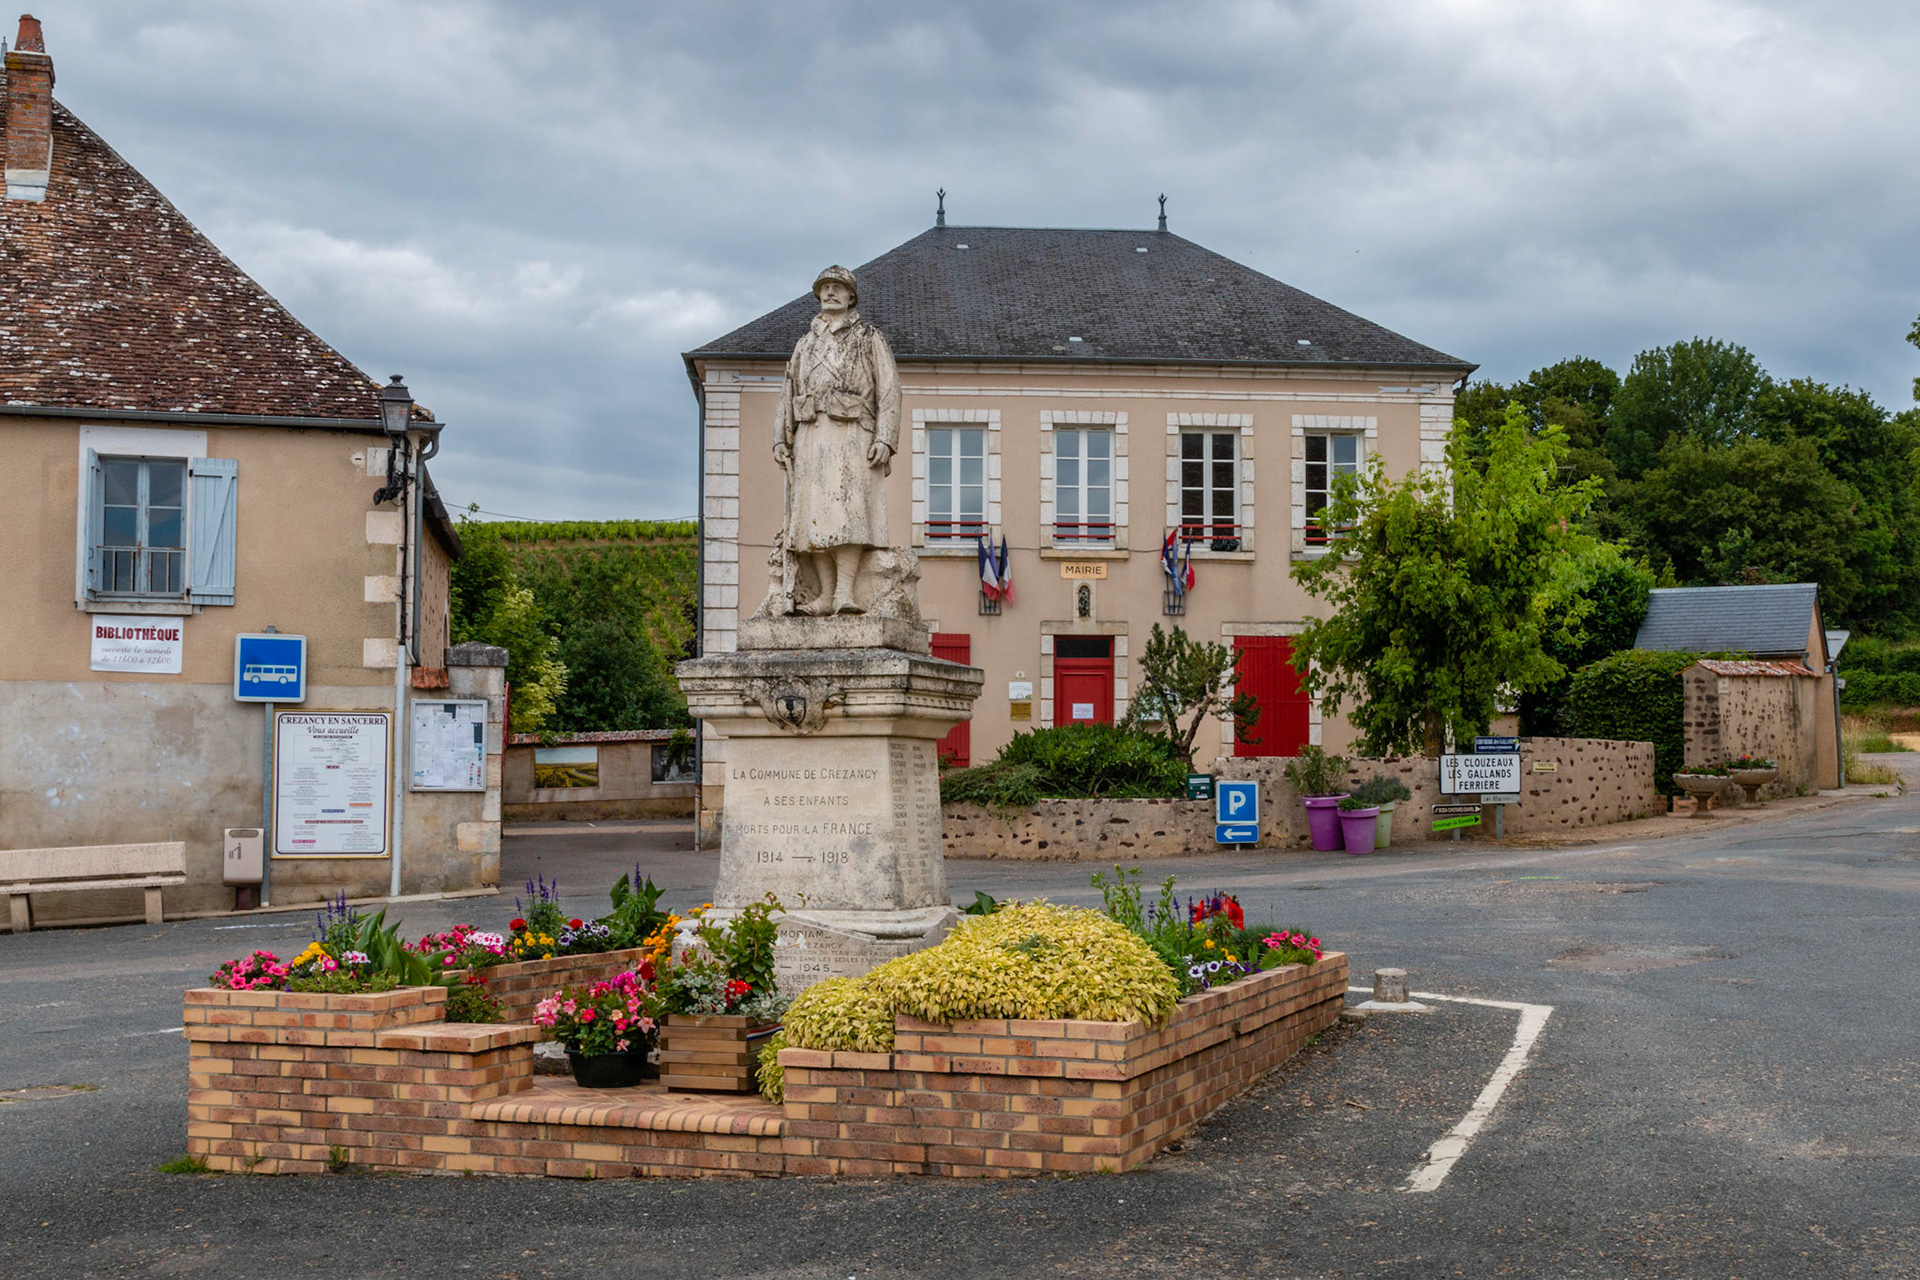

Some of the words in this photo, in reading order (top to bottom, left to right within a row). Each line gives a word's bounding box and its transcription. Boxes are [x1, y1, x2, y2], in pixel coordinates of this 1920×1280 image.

[1065, 565, 1103, 575] MAIRIE
[95, 626, 179, 641] BIBLIOTHÈQUE
[144, 646, 172, 655] samedi
[280, 716, 327, 725] CREZANCY
[328, 717, 340, 725] EN
[341, 717, 386, 726] SANCERRE
[306, 726, 326, 734] Vous
[327, 726, 360, 734] accueille
[1445, 758, 1460, 768] LES
[1463, 758, 1514, 768] CLOUZEAUX
[733, 769, 746, 780] LA
[749, 768, 801, 780] COMMUNE
[804, 769, 816, 780] DE
[1448, 769, 1462, 779] LES
[1467, 769, 1512, 779] GALLANDS
[774, 796, 795, 806] SES
[799, 795, 849, 806] ENFANTS
[1229, 790, 1246, 815] P
[735, 824, 769, 835] MORTS
[773, 824, 799, 835] POUR
[804, 825, 818, 835] LA
[823, 822, 872, 835] FRANCE
[757, 851, 783, 863] 1914
[822, 851, 849, 864] 1918
[799, 963, 830, 973] 1945
